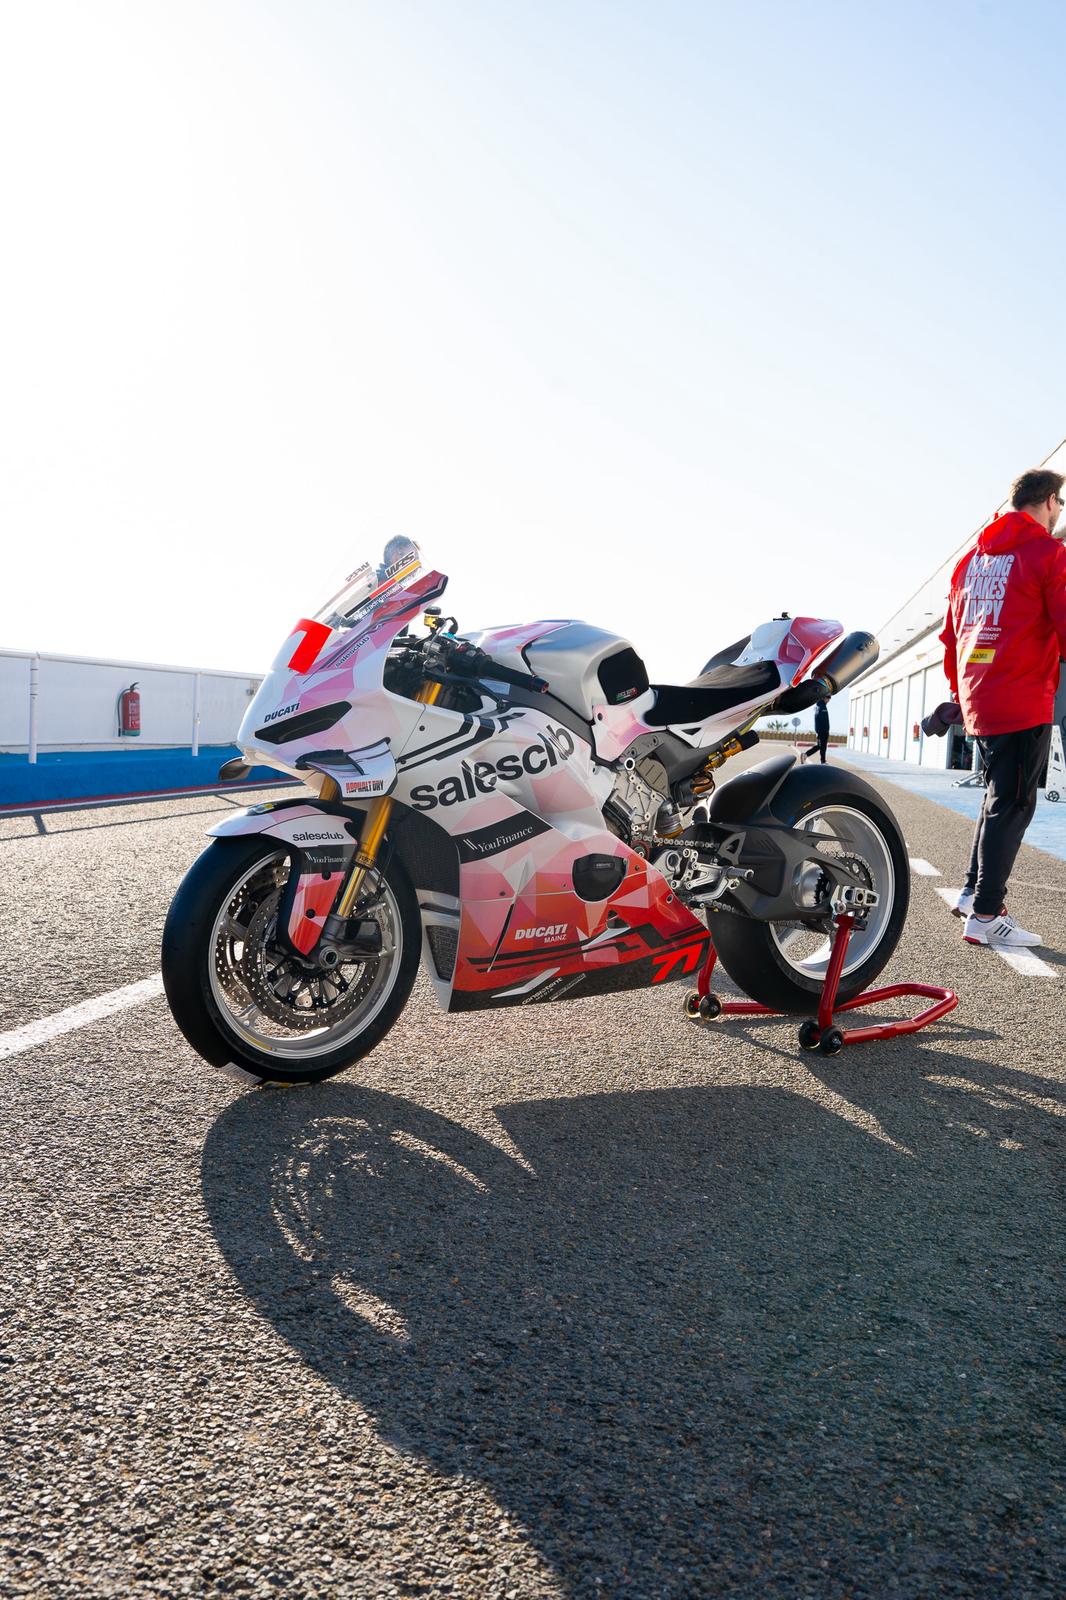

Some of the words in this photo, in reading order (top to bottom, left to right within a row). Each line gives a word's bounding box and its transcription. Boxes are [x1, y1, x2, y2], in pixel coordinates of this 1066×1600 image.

[387, 552, 416, 577] WRS
[966, 555, 1015, 577] RACING
[964, 576, 1008, 600] MAKES
[263, 702, 300, 723] DUCATI
[292, 831, 344, 841] salesclub
[478, 826, 533, 853] YouFinance
[514, 923, 568, 940] DUCATI
[543, 934, 567, 944] MAINZ
